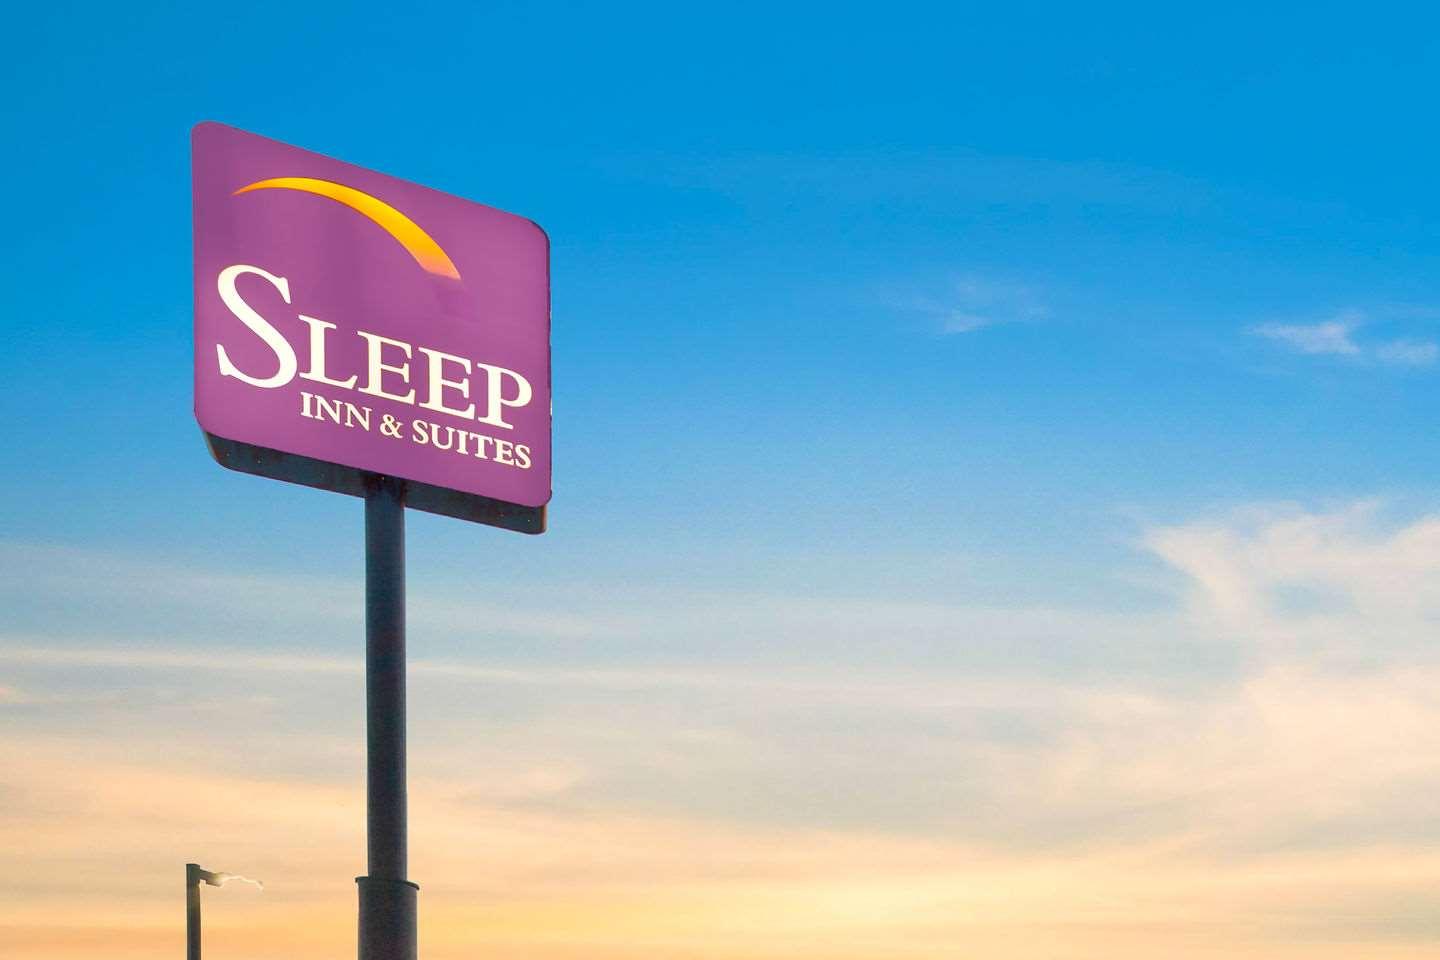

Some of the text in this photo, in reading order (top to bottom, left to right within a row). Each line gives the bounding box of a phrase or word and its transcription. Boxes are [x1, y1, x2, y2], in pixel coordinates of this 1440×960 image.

[216, 264, 532, 430] SLEEP
[300, 392, 532, 470] INN & SUITES
